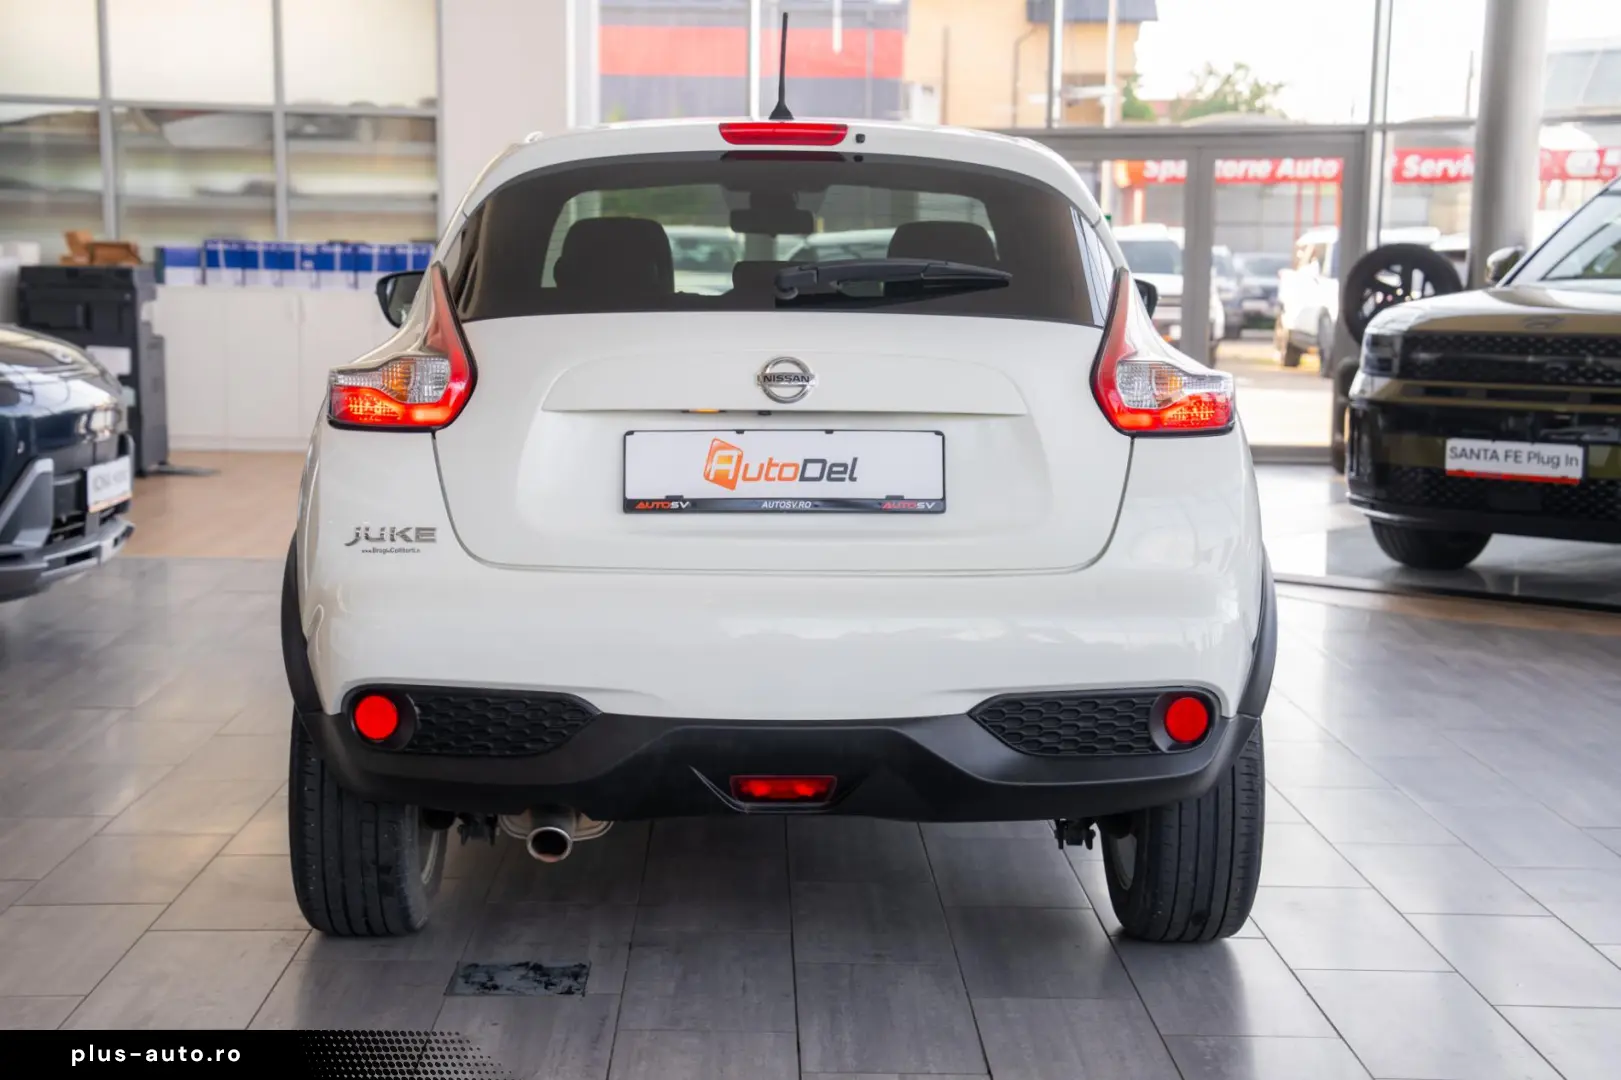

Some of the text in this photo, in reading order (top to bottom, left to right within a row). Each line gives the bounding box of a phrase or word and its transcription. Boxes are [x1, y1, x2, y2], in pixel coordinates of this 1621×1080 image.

[1276, 156, 1339, 179] Auto
[1402, 153, 1473, 178] Servi
[763, 374, 810, 384] NISSAN
[706, 447, 858, 484] AutoDel
[1449, 446, 1579, 469] SANTA FE Plug In
[634, 500, 690, 510] AUTOSV
[761, 499, 812, 510] AUTOSV.RO
[882, 500, 936, 510] AUTOSV
